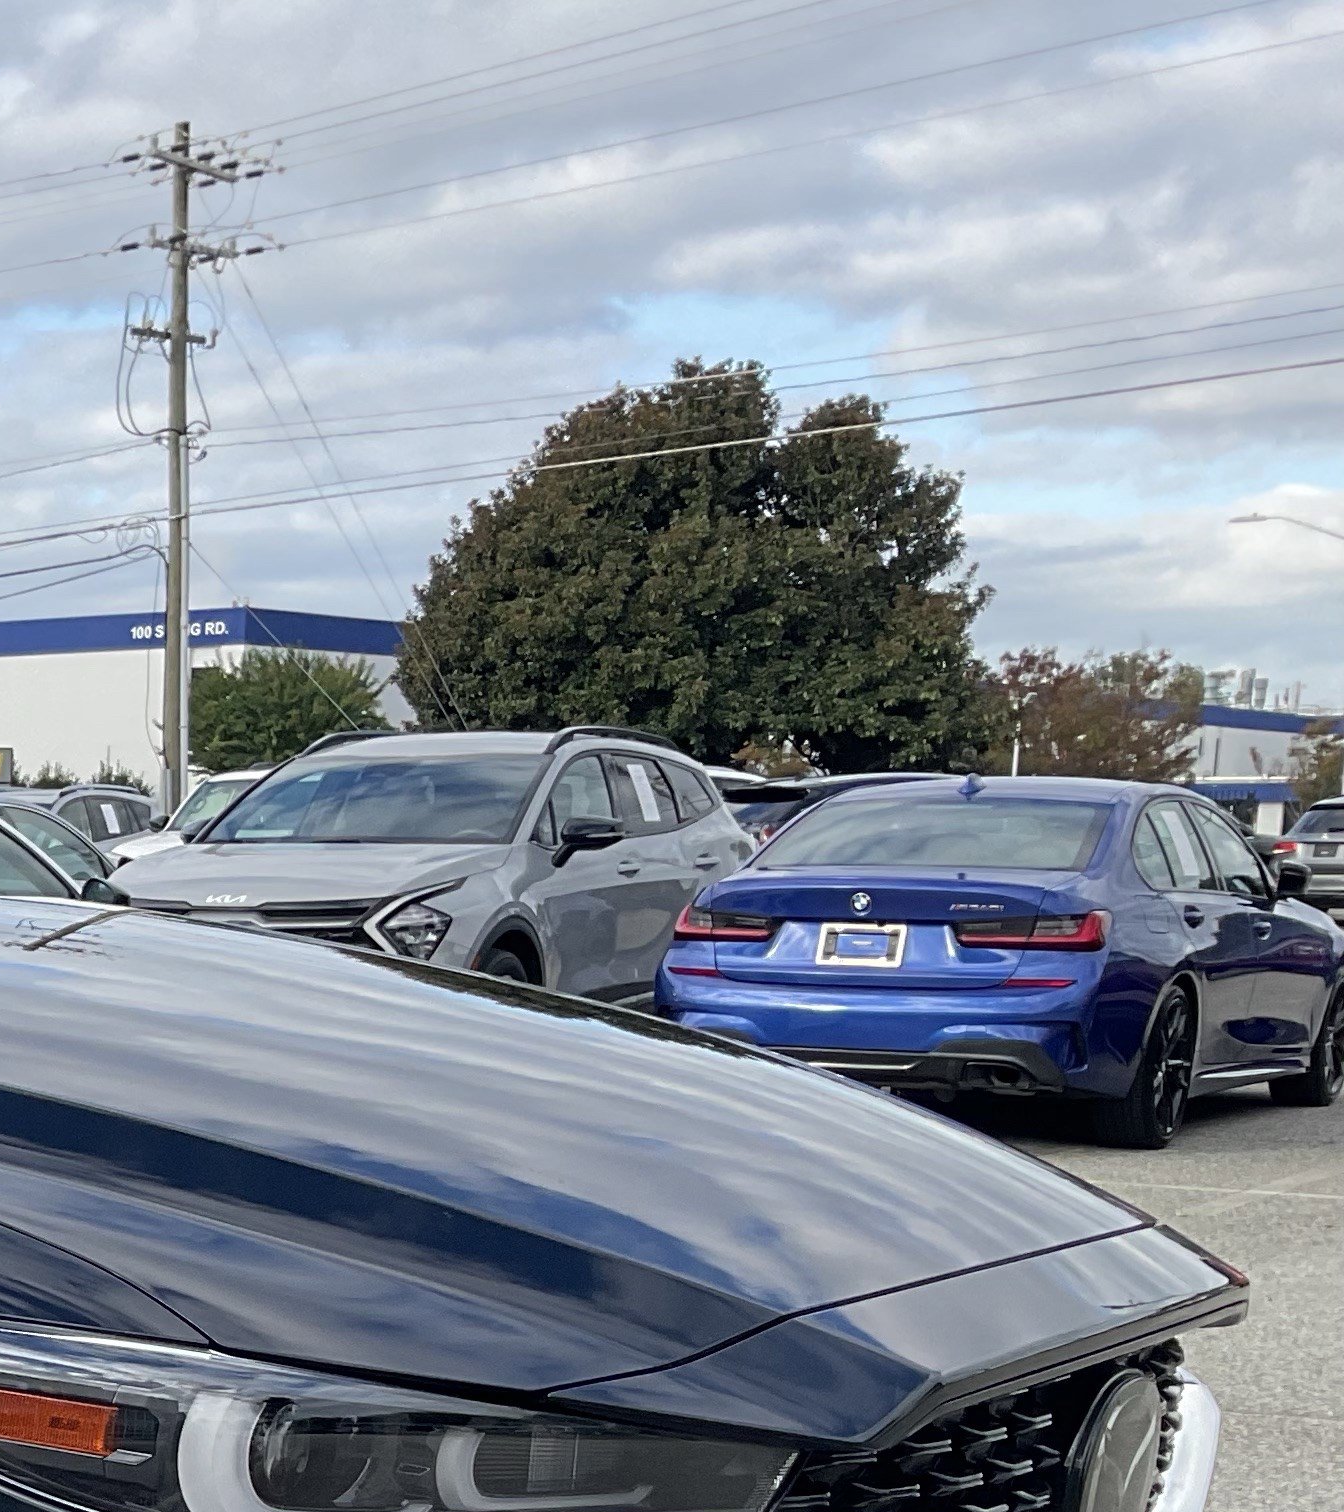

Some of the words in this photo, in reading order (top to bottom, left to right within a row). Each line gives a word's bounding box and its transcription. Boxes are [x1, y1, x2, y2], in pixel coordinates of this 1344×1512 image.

[130, 625, 152, 640] 100
[204, 621, 229, 636] RD.
[205, 894, 248, 904] KIA
